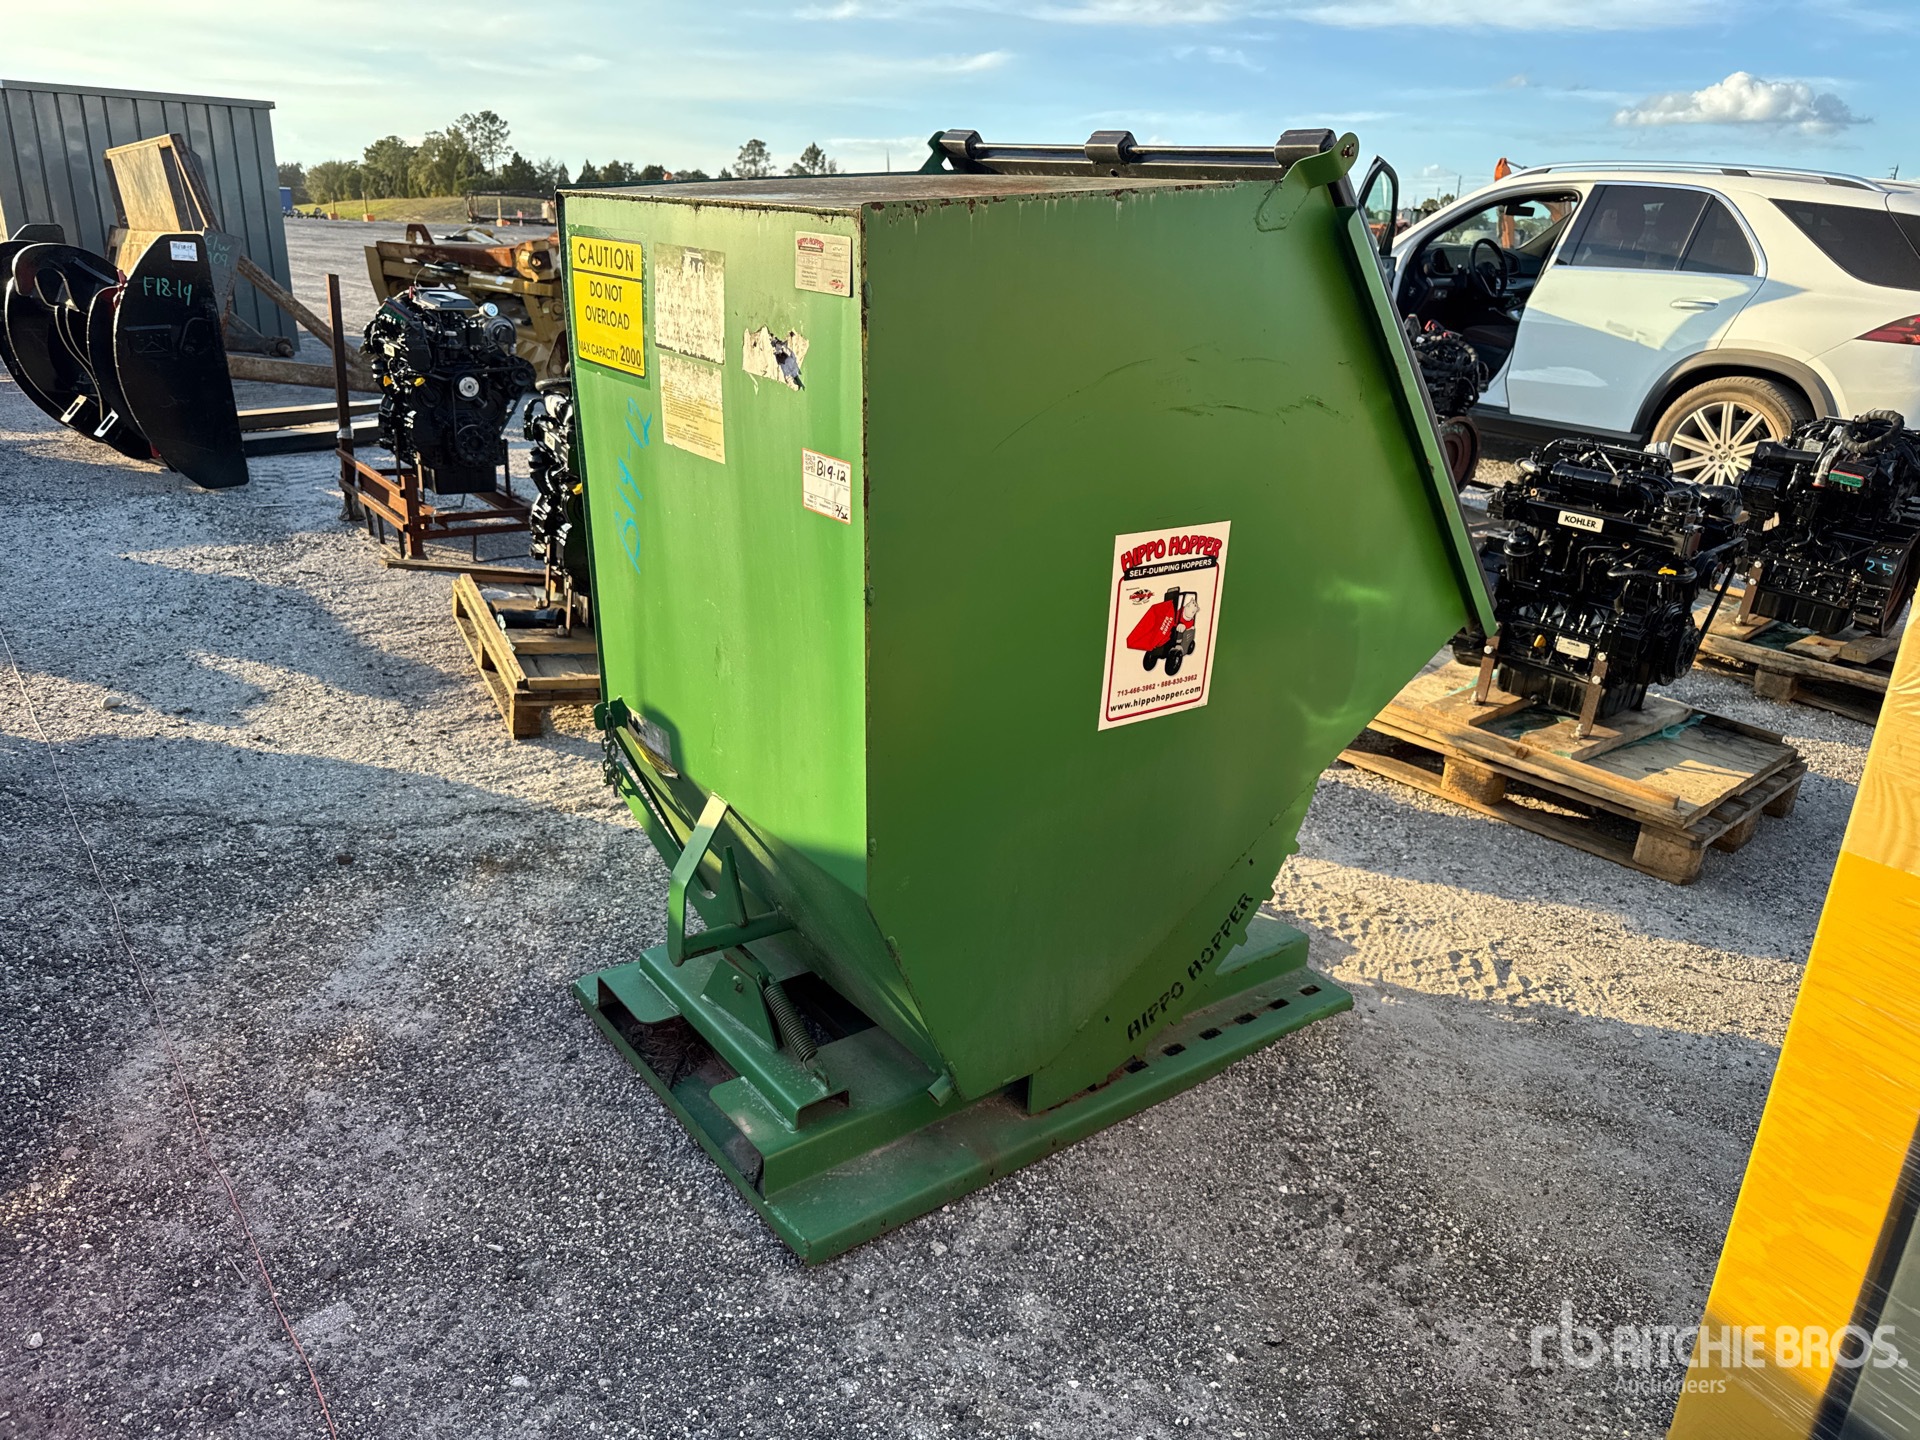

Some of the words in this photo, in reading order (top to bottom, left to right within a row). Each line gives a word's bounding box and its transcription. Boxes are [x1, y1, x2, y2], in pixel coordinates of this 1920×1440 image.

[578, 243, 634, 272] CAUTION
[143, 276, 193, 306] F18-14
[590, 281, 603, 299] DO
[604, 283, 622, 303] NOT
[585, 305, 630, 330] OVERLOAD
[578, 340, 591, 353] MAX
[590, 343, 619, 362] CAPACITY
[620, 345, 642, 367] 2000
[1564, 515, 1597, 528] KOHLER
[1120, 539, 1166, 573] HIPPO
[1168, 535, 1222, 560] HOPPER
[1129, 563, 1180, 577] SELF-DUMPING
[1181, 558, 1212, 570] HOPPERS
[1110, 686, 1201, 712] www.hippohopper.com
[1127, 981, 1185, 1042] HIPPO
[1187, 892, 1254, 982] HOPPER
